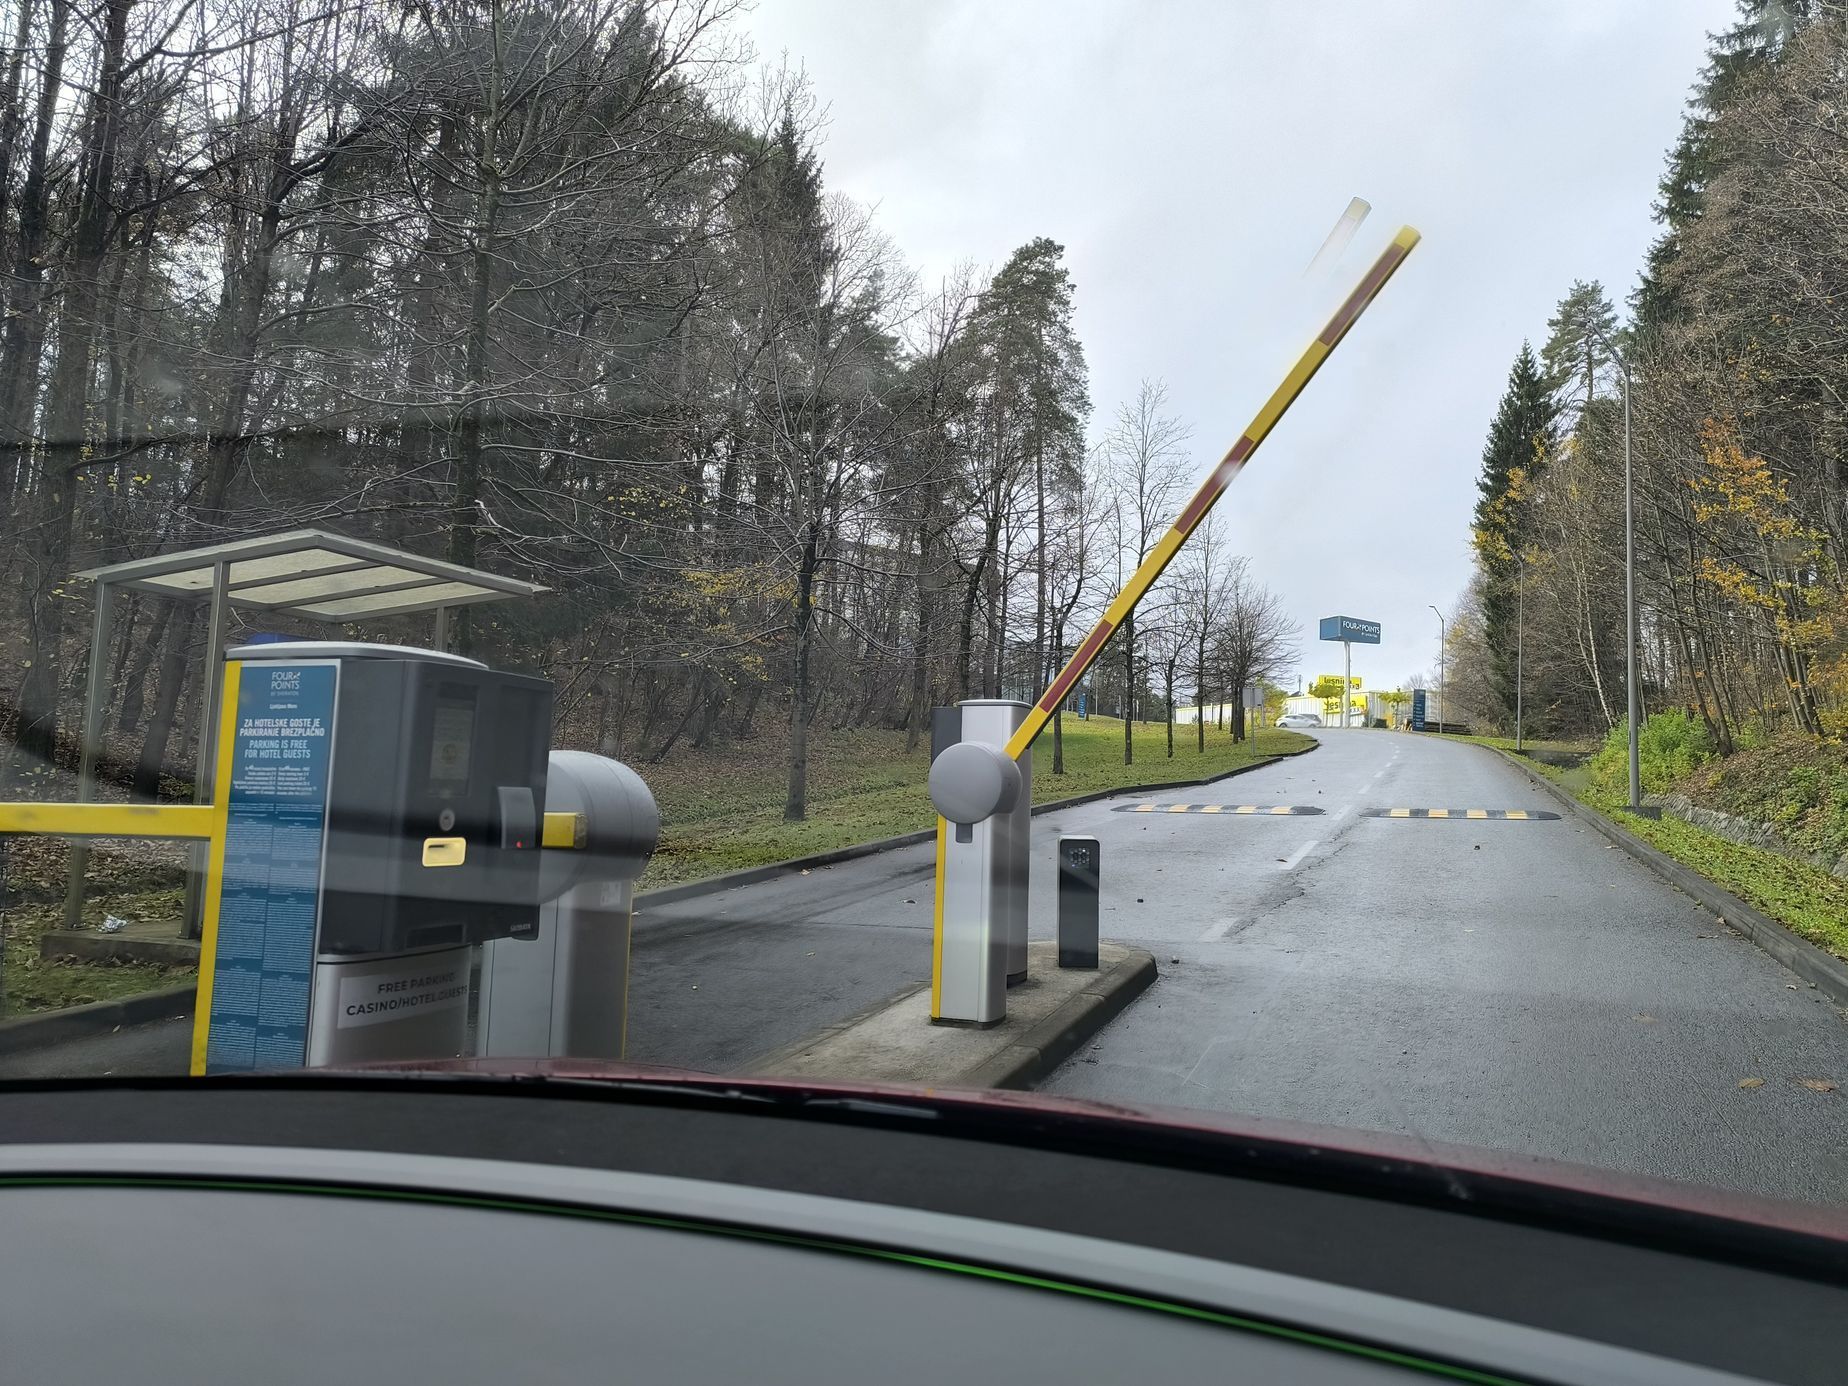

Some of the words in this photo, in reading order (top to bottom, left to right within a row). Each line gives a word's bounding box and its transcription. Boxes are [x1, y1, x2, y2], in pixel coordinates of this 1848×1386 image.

[1343, 620, 1357, 630] FOUR
[1361, 624, 1380, 634] POINTS
[271, 671, 294, 680] FOUR
[271, 680, 300, 690] POINTS
[244, 718, 253, 728] ZA
[254, 718, 289, 728] HOTELSKE
[289, 718, 312, 728] GOSTE
[312, 718, 321, 728] JE
[239, 728, 280, 737] PARKIRANJE
[280, 727, 325, 737] BREZPLAČNO
[249, 739, 280, 749] PARKING
[280, 739, 289, 749] IS
[289, 739, 308, 749] FREE
[244, 749, 258, 759] FOR
[259, 749, 281, 759] HOTEL
[282, 749, 311, 759] GUESTS
[377, 980, 408, 994] FREE
[410, 972, 456, 989] PARKING
[346, 993, 436, 1016] CASINO/HOTEL
